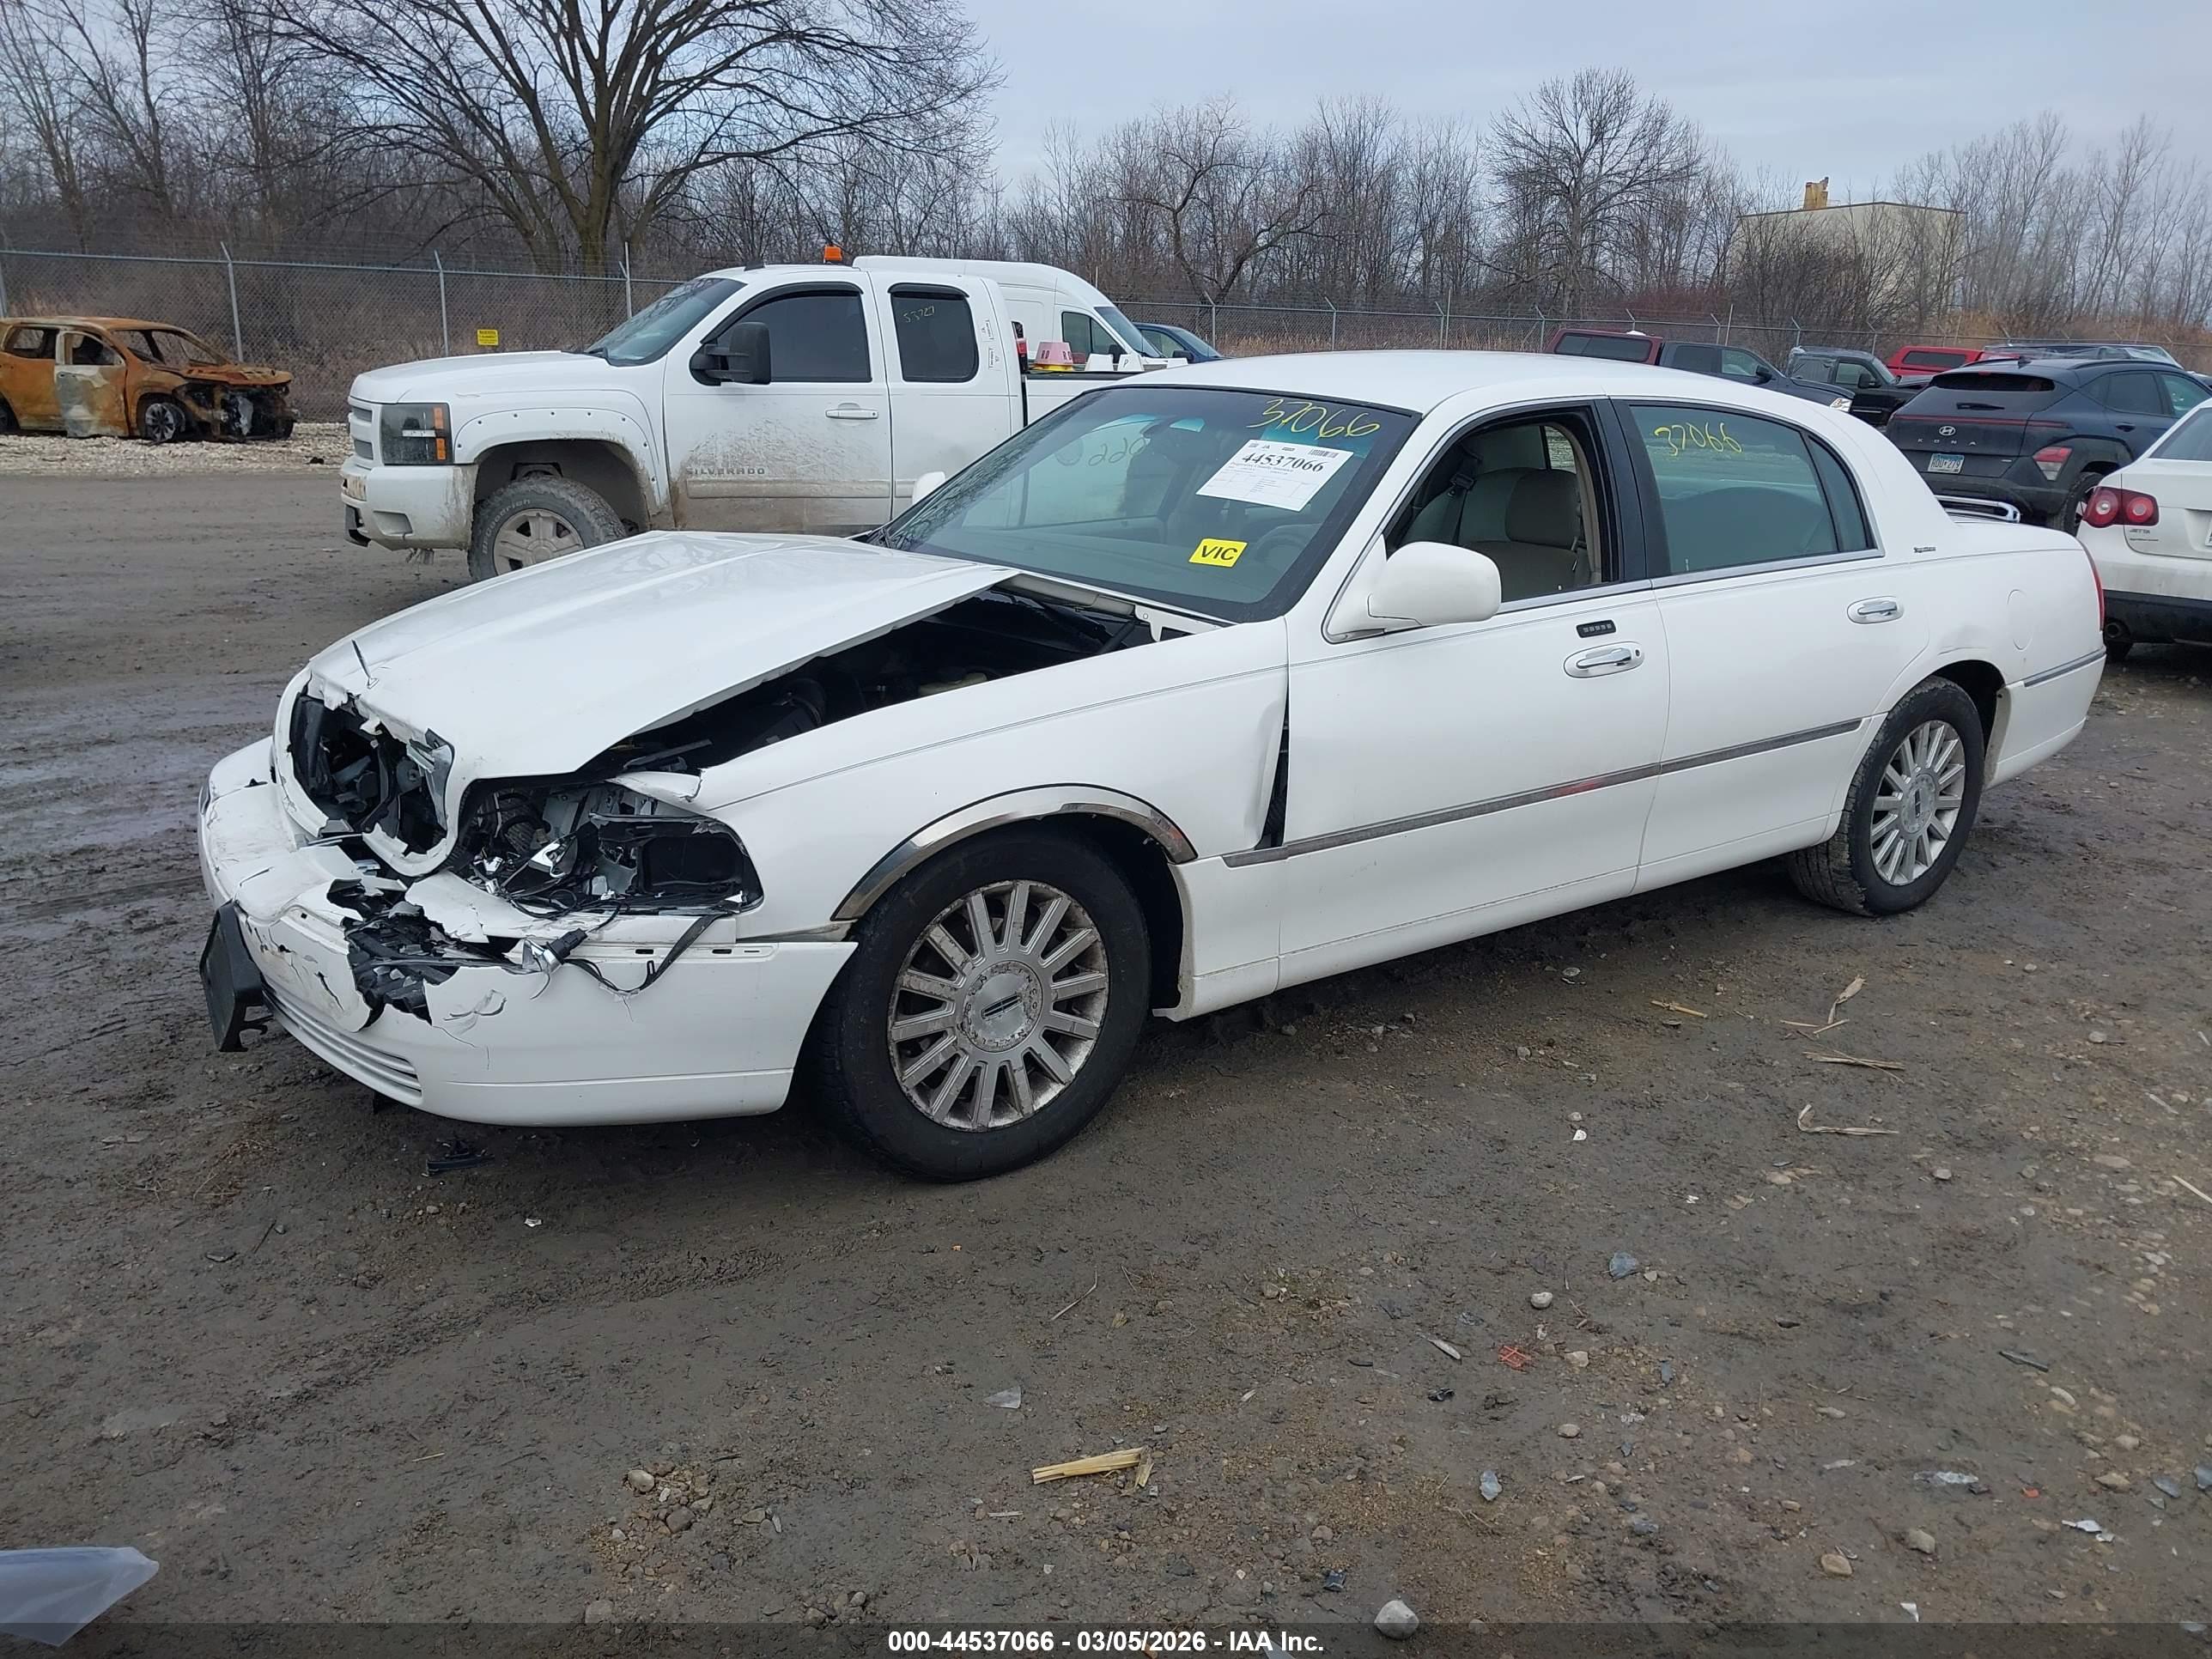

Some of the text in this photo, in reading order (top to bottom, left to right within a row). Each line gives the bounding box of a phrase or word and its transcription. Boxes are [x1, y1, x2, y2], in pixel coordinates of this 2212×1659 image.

[1246, 398, 1380, 440] 37066
[1654, 422, 1742, 456] 37066
[1242, 453, 1328, 472] 44537066
[1201, 545, 1237, 561] VIC
